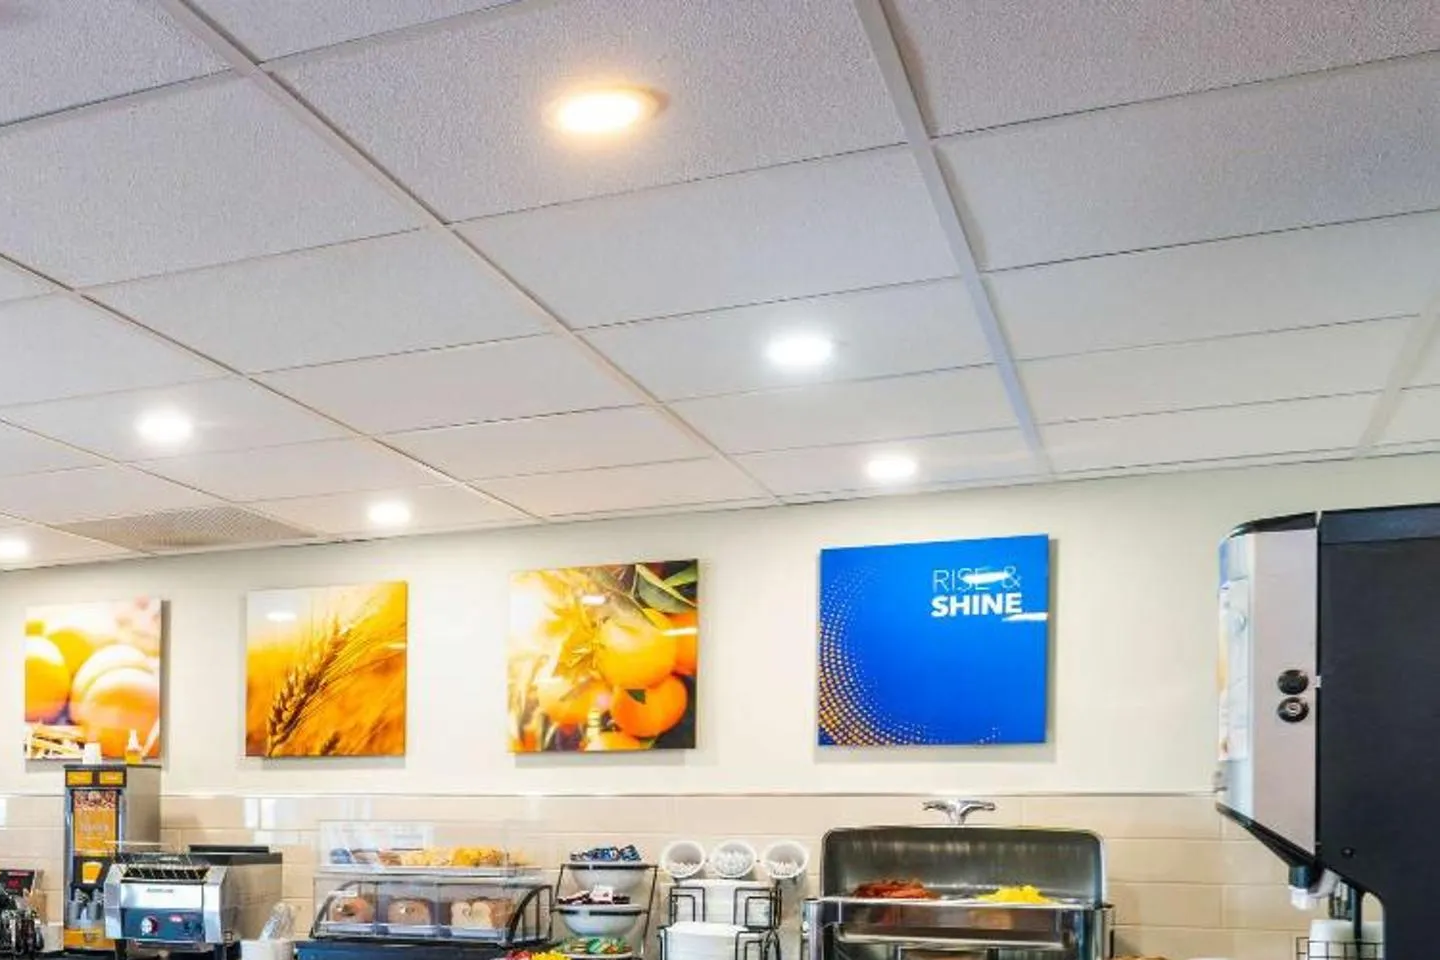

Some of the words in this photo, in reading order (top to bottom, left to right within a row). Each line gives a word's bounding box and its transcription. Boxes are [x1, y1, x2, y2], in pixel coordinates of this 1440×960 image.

[932, 568, 991, 592] RISE
[1001, 565, 1021, 589] &
[931, 593, 1022, 617] SHINE
